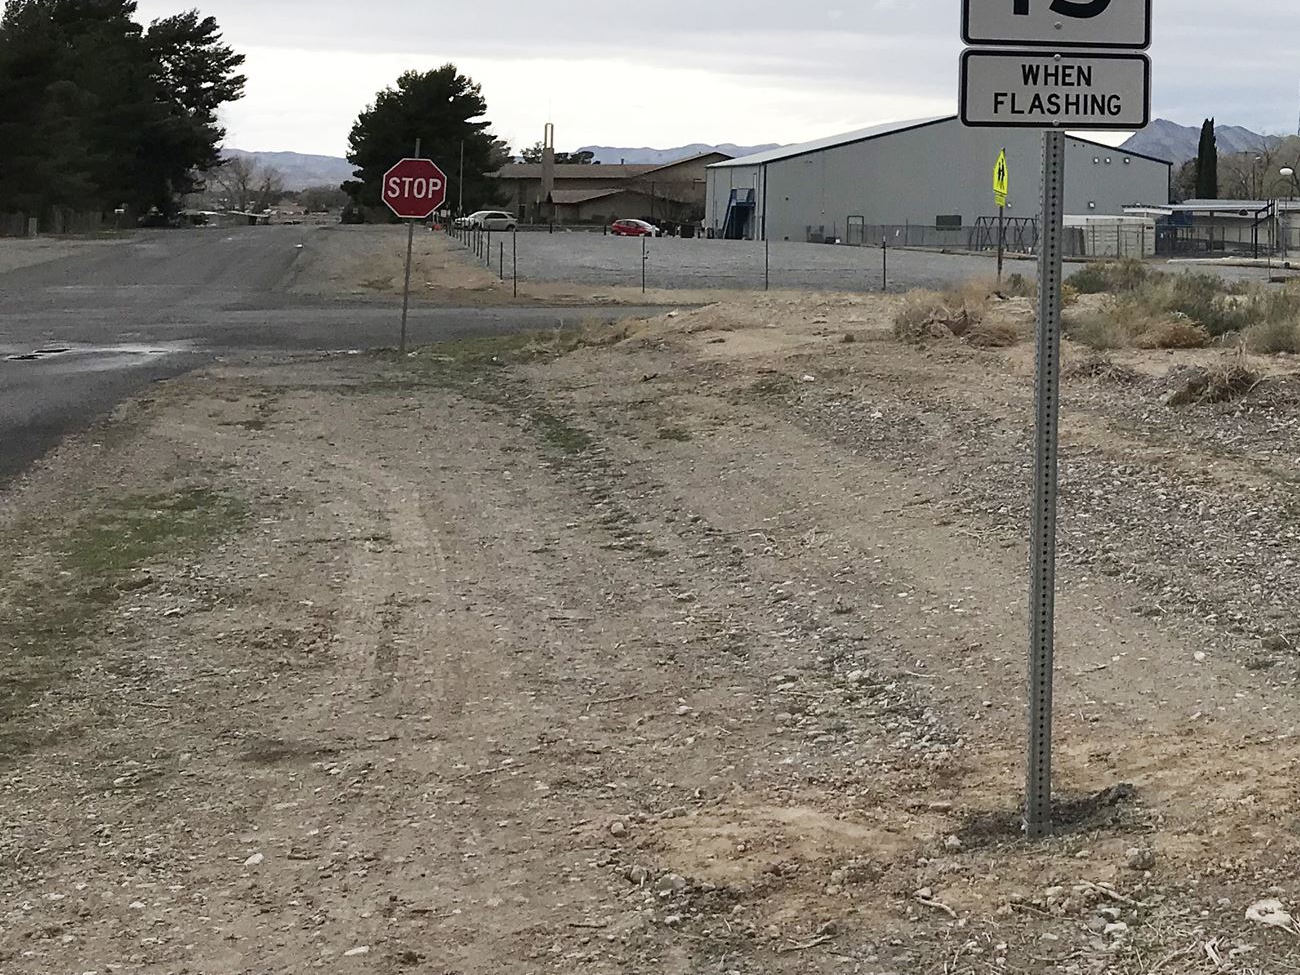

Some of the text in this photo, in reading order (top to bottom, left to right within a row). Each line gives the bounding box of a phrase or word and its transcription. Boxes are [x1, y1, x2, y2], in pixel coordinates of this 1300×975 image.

[1021, 64, 1092, 87] WHEN
[993, 92, 1121, 116] FLASHING
[387, 177, 442, 198] STOP
